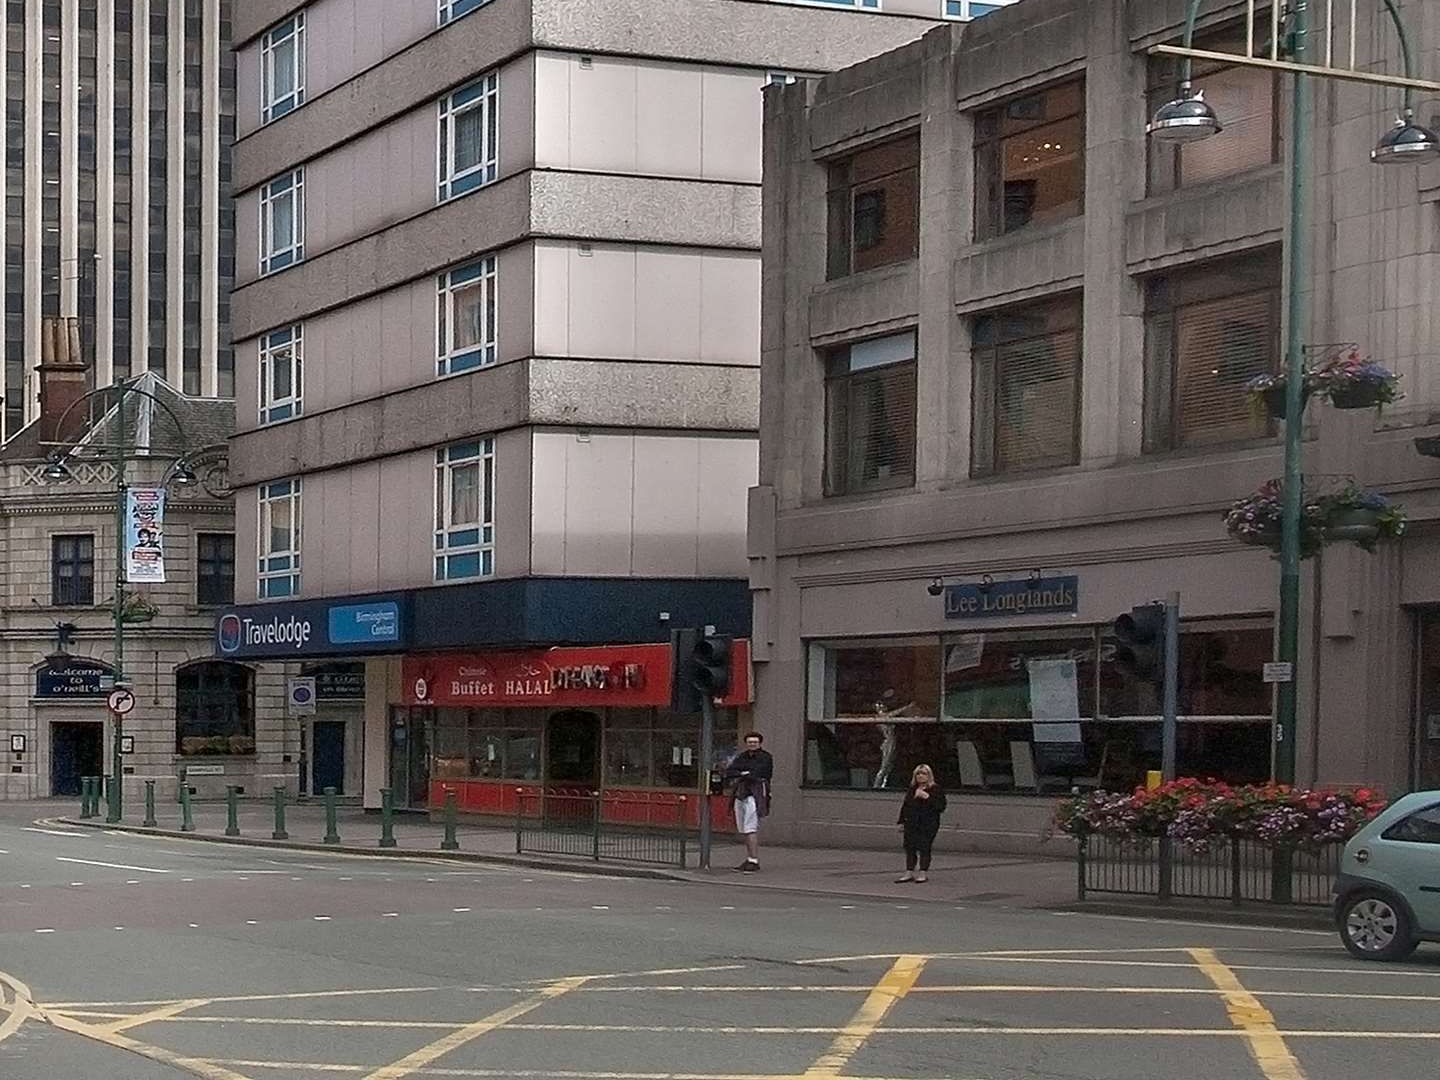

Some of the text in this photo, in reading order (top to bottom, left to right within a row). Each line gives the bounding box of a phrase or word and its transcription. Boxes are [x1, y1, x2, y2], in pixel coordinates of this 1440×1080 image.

[946, 583, 1073, 613] Lee Longlands
[243, 615, 311, 648] Travelodge
[371, 622, 395, 636] Central
[451, 680, 494, 695] Buffet
[505, 680, 552, 695] HALAL
